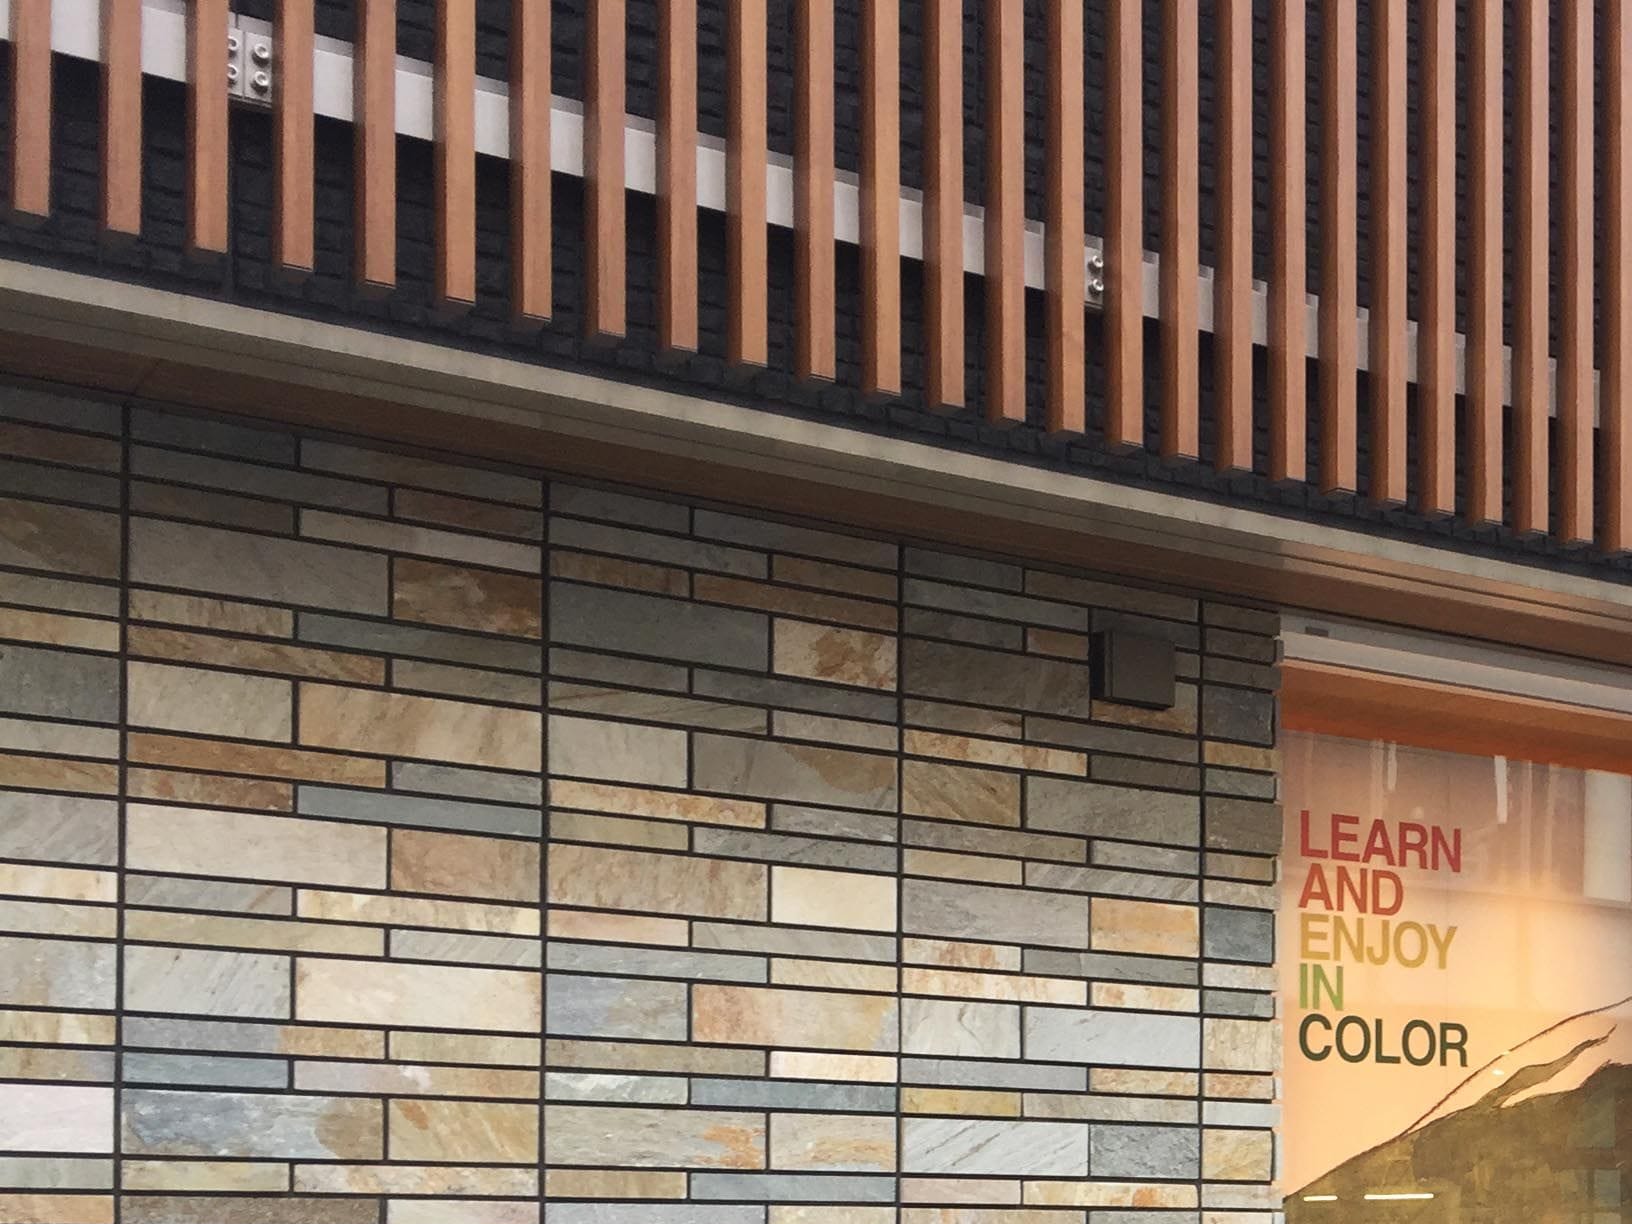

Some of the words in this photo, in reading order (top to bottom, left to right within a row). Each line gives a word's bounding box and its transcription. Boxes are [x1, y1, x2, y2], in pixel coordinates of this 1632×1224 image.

[1300, 810, 1461, 873] LEARN
[1298, 863, 1404, 916] AND
[1300, 912, 1457, 970] ENJOY
[1299, 963, 1343, 1011] IN
[1299, 1013, 1468, 1067] COLOR
